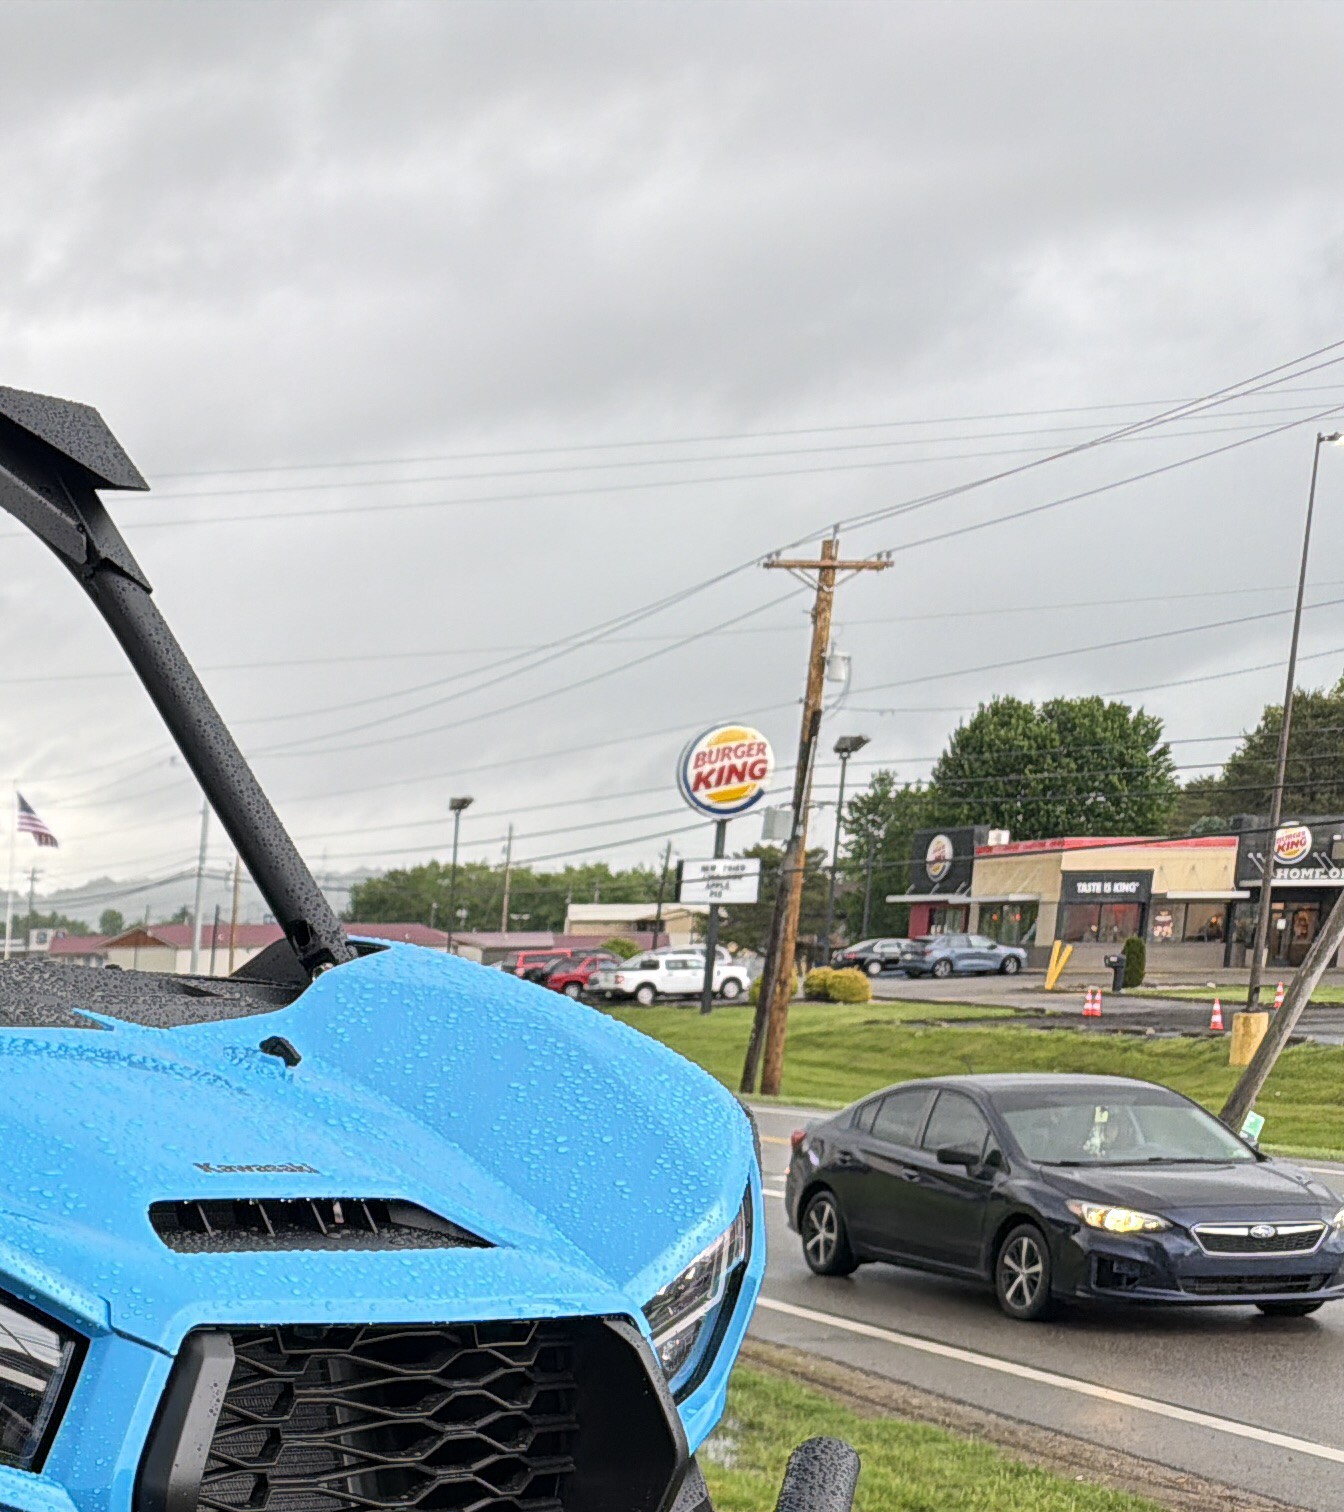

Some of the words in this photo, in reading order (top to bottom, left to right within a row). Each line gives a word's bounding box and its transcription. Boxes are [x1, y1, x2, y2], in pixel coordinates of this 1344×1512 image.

[693, 741, 767, 770] BURGER
[692, 758, 769, 793] KING
[1276, 838, 1307, 853] KING
[1276, 868, 1328, 879] HOME
[1328, 867, 1344, 879] O
